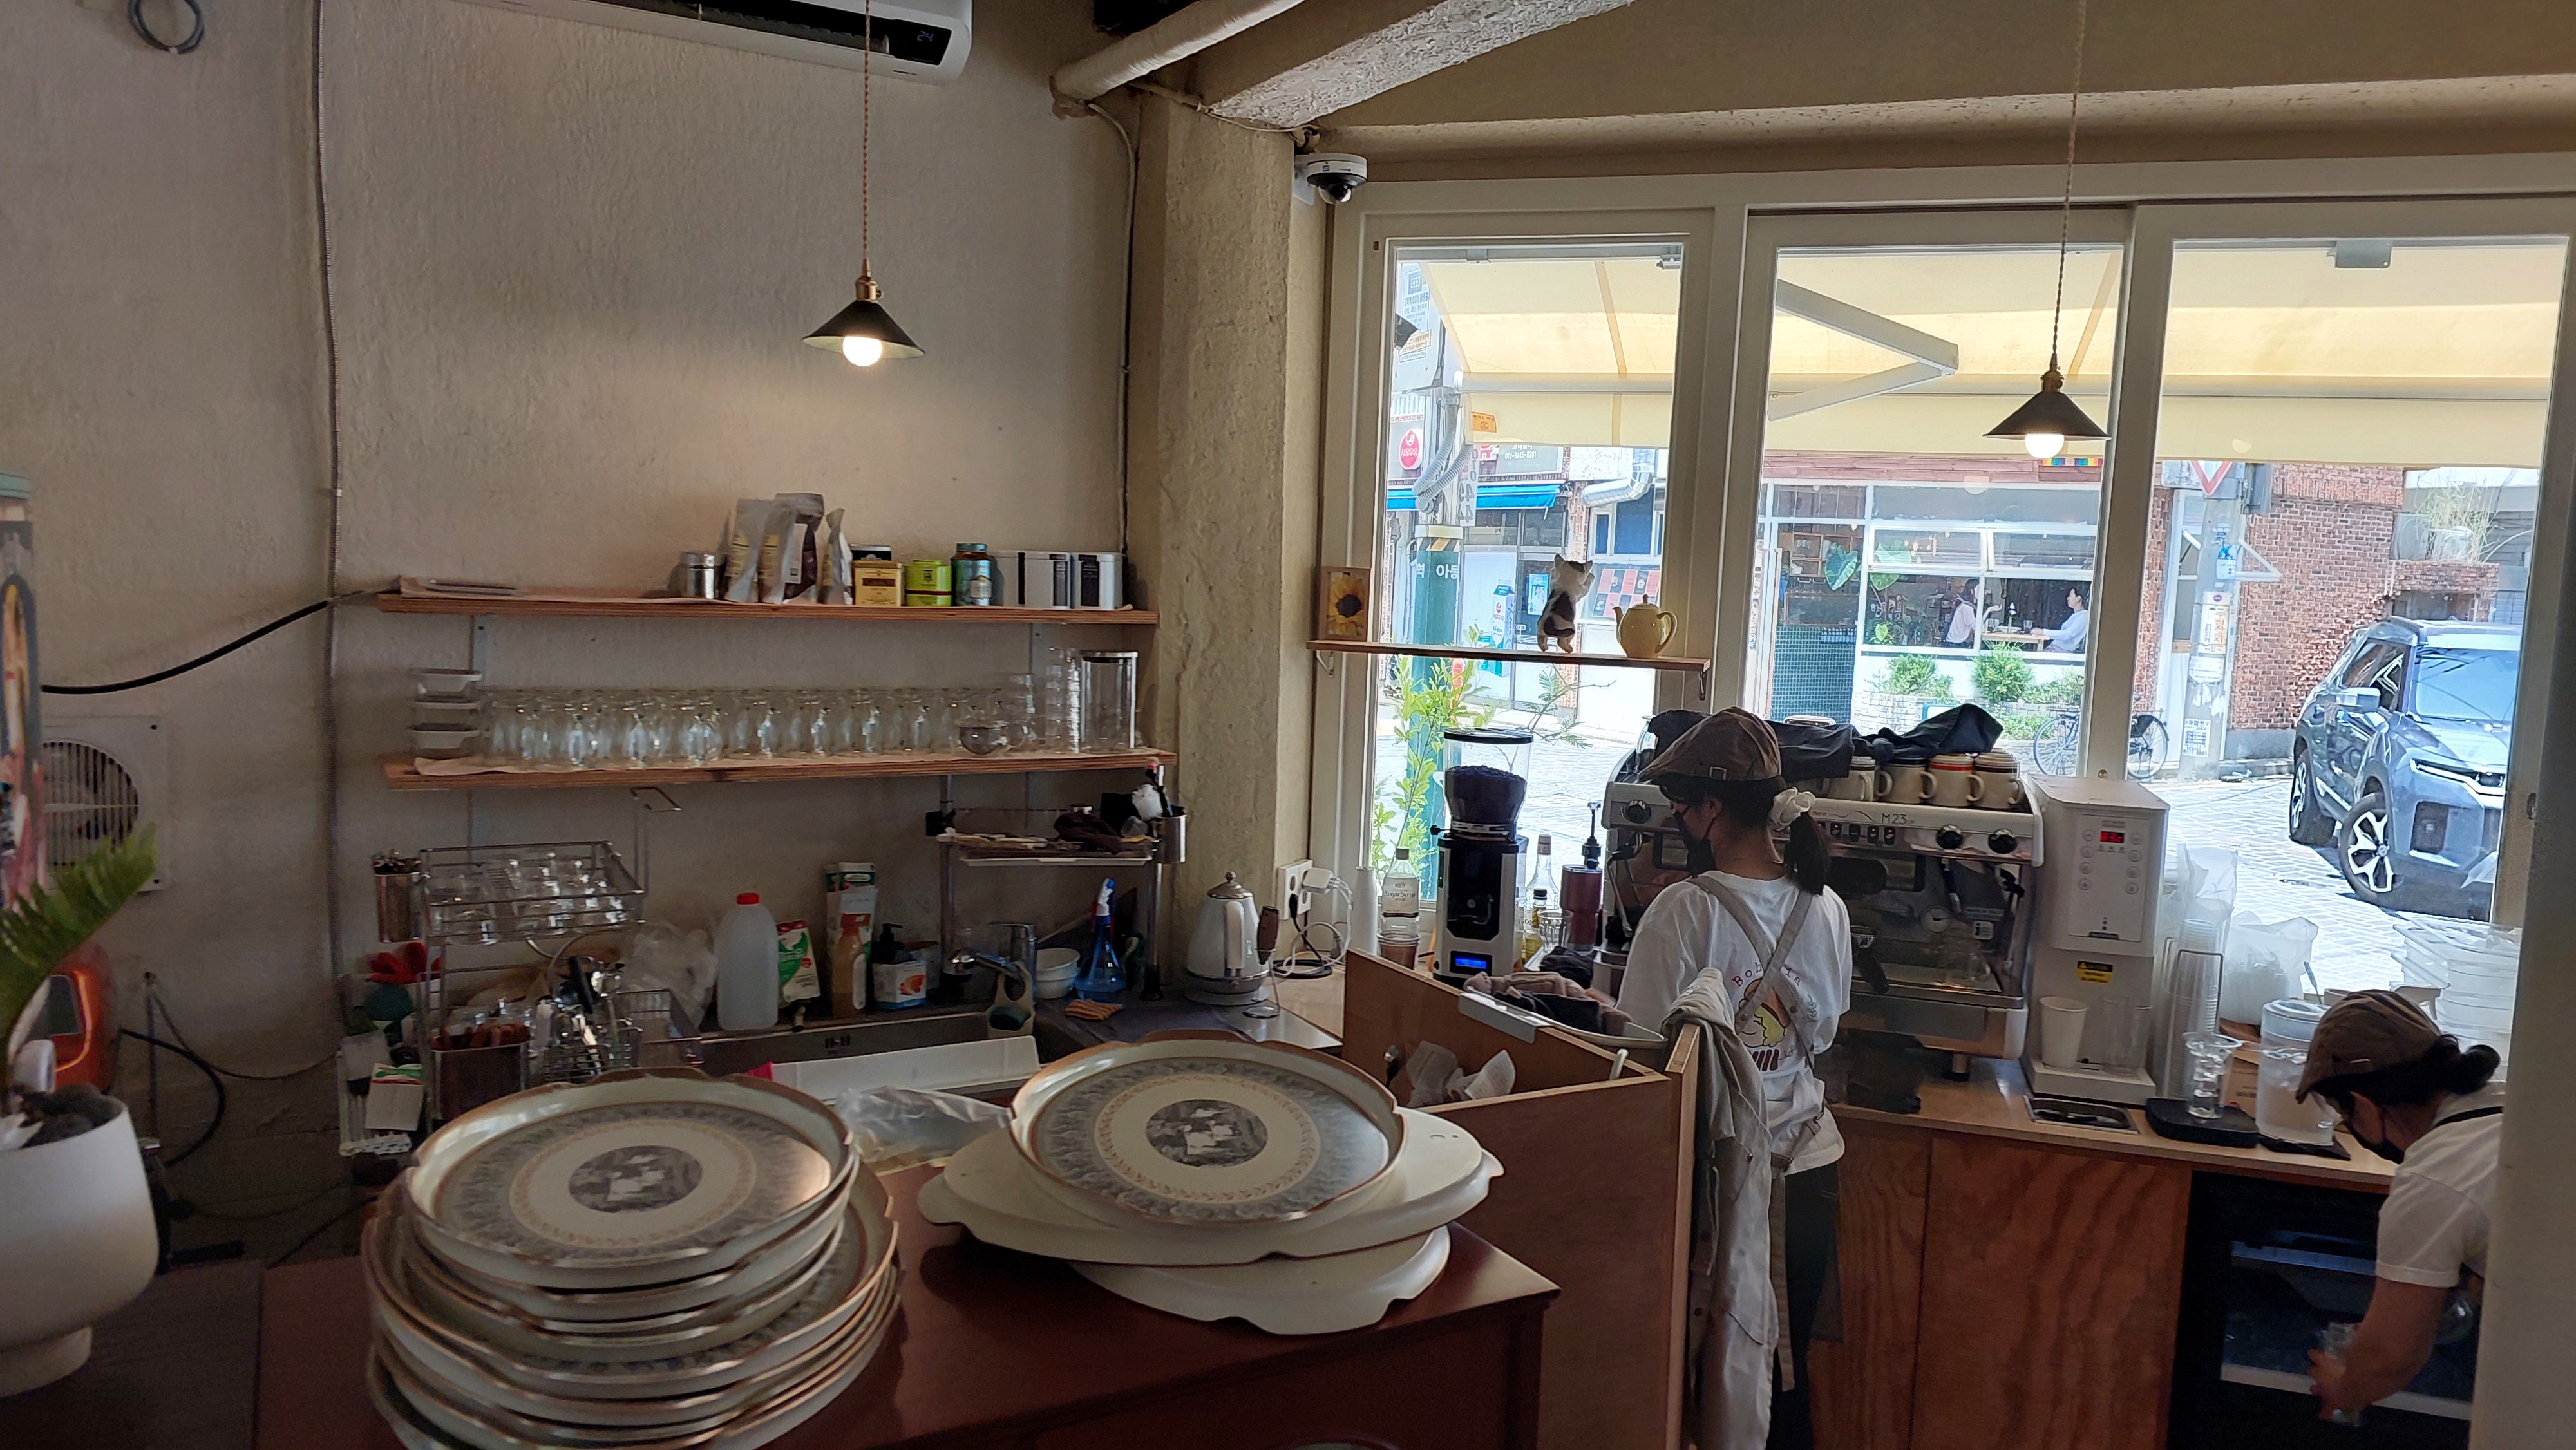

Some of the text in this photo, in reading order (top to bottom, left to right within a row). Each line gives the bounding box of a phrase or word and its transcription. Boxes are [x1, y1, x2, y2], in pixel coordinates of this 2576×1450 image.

[916, 30, 934, 42] 24
[1436, 564, 1457, 579] 아동
[1882, 813, 1907, 824] M23
